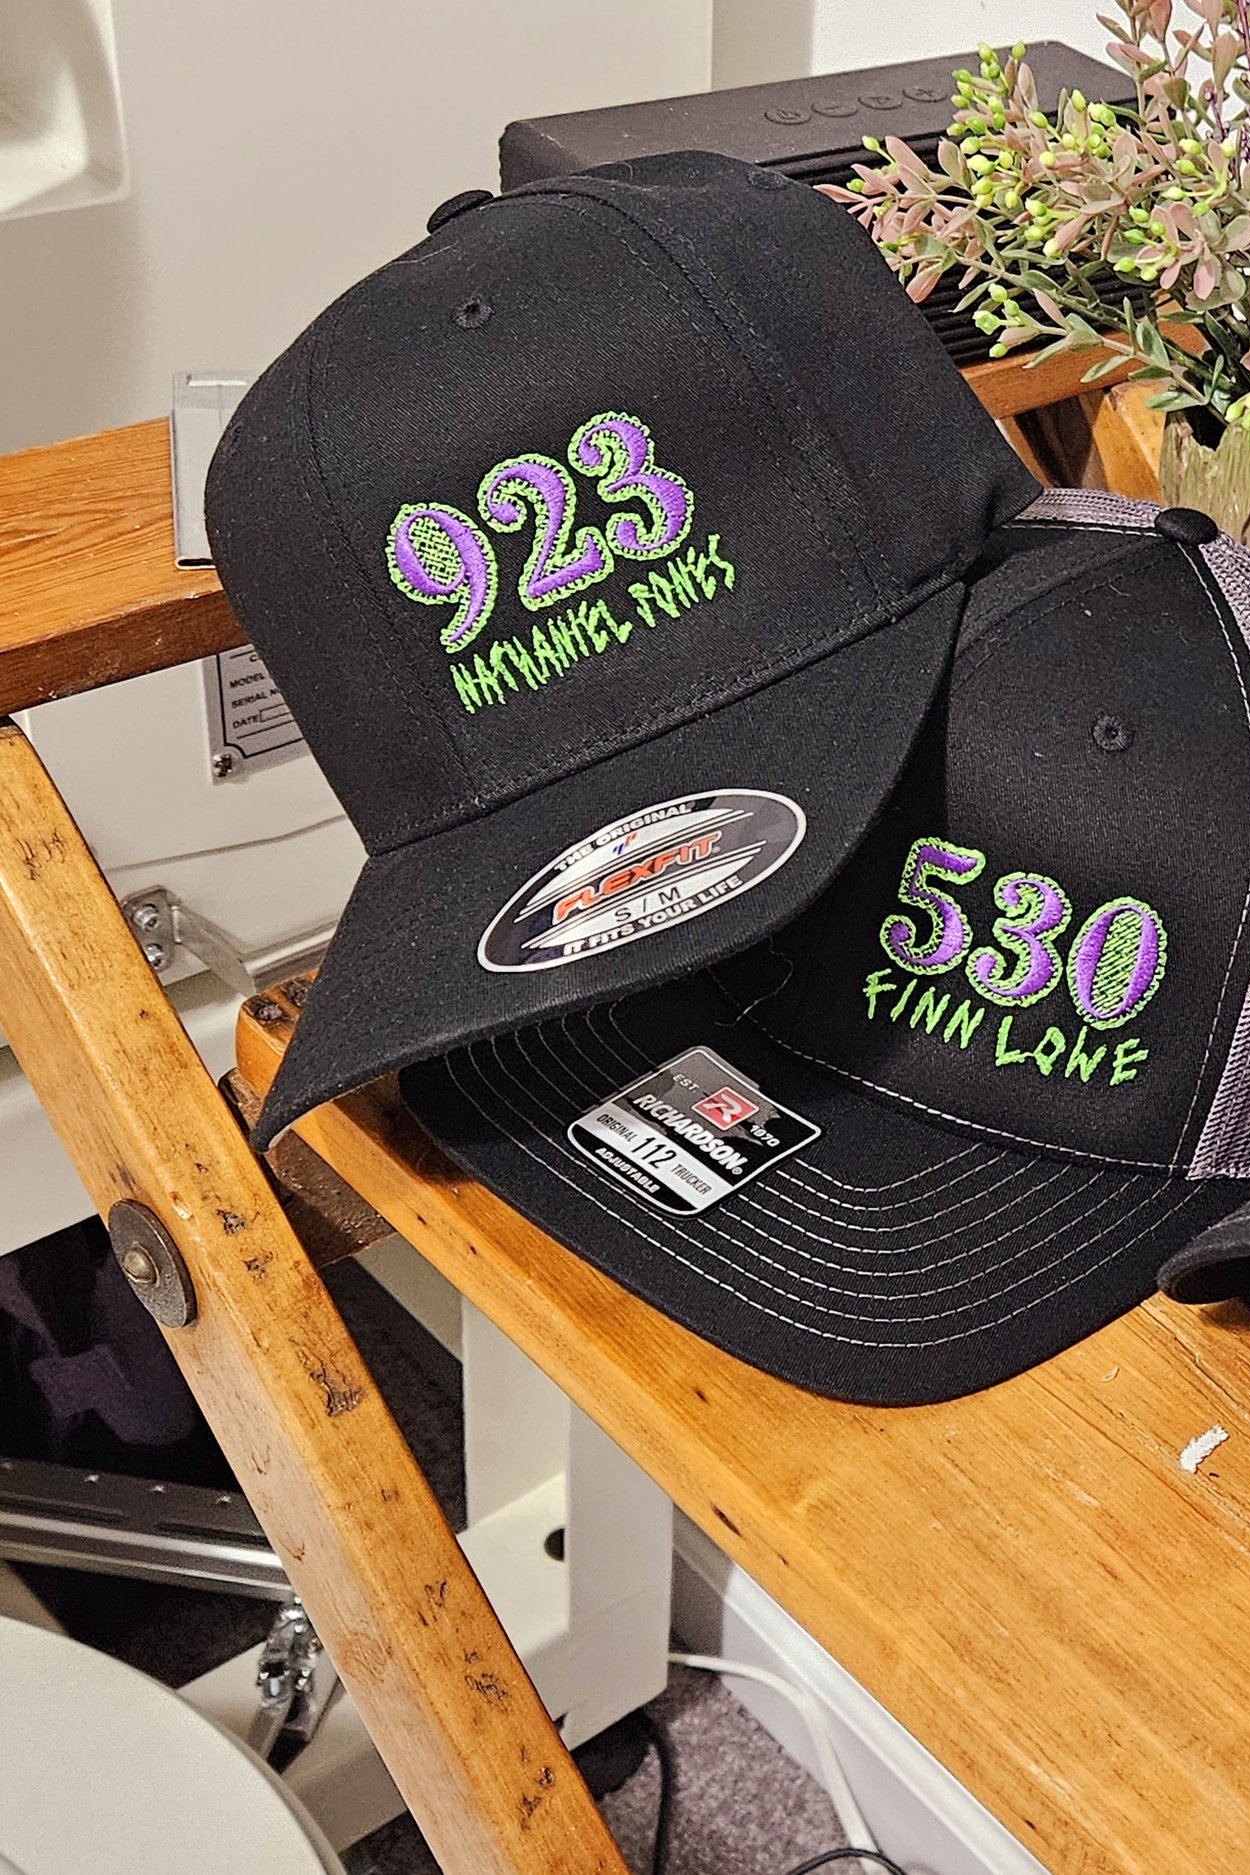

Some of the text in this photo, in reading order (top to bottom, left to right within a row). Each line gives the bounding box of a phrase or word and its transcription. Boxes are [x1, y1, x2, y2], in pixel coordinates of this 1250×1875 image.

[385, 411, 694, 653] 923
[450, 533, 734, 713] NATHANIEL JONES
[229, 672, 265, 688] MODEL
[231, 692, 267, 708] SERIAL
[232, 714, 259, 729] DATE
[552, 830, 722, 926] FLEXFIT
[554, 803, 693, 872] THE ORIGINAL
[563, 875, 743, 956] IT FITS YOUR LIFE
[879, 836, 1168, 1031] 530
[862, 968, 1149, 1086] FINN LOWE
[596, 1113, 713, 1196] ORIGINAL 112 TRUCKER
